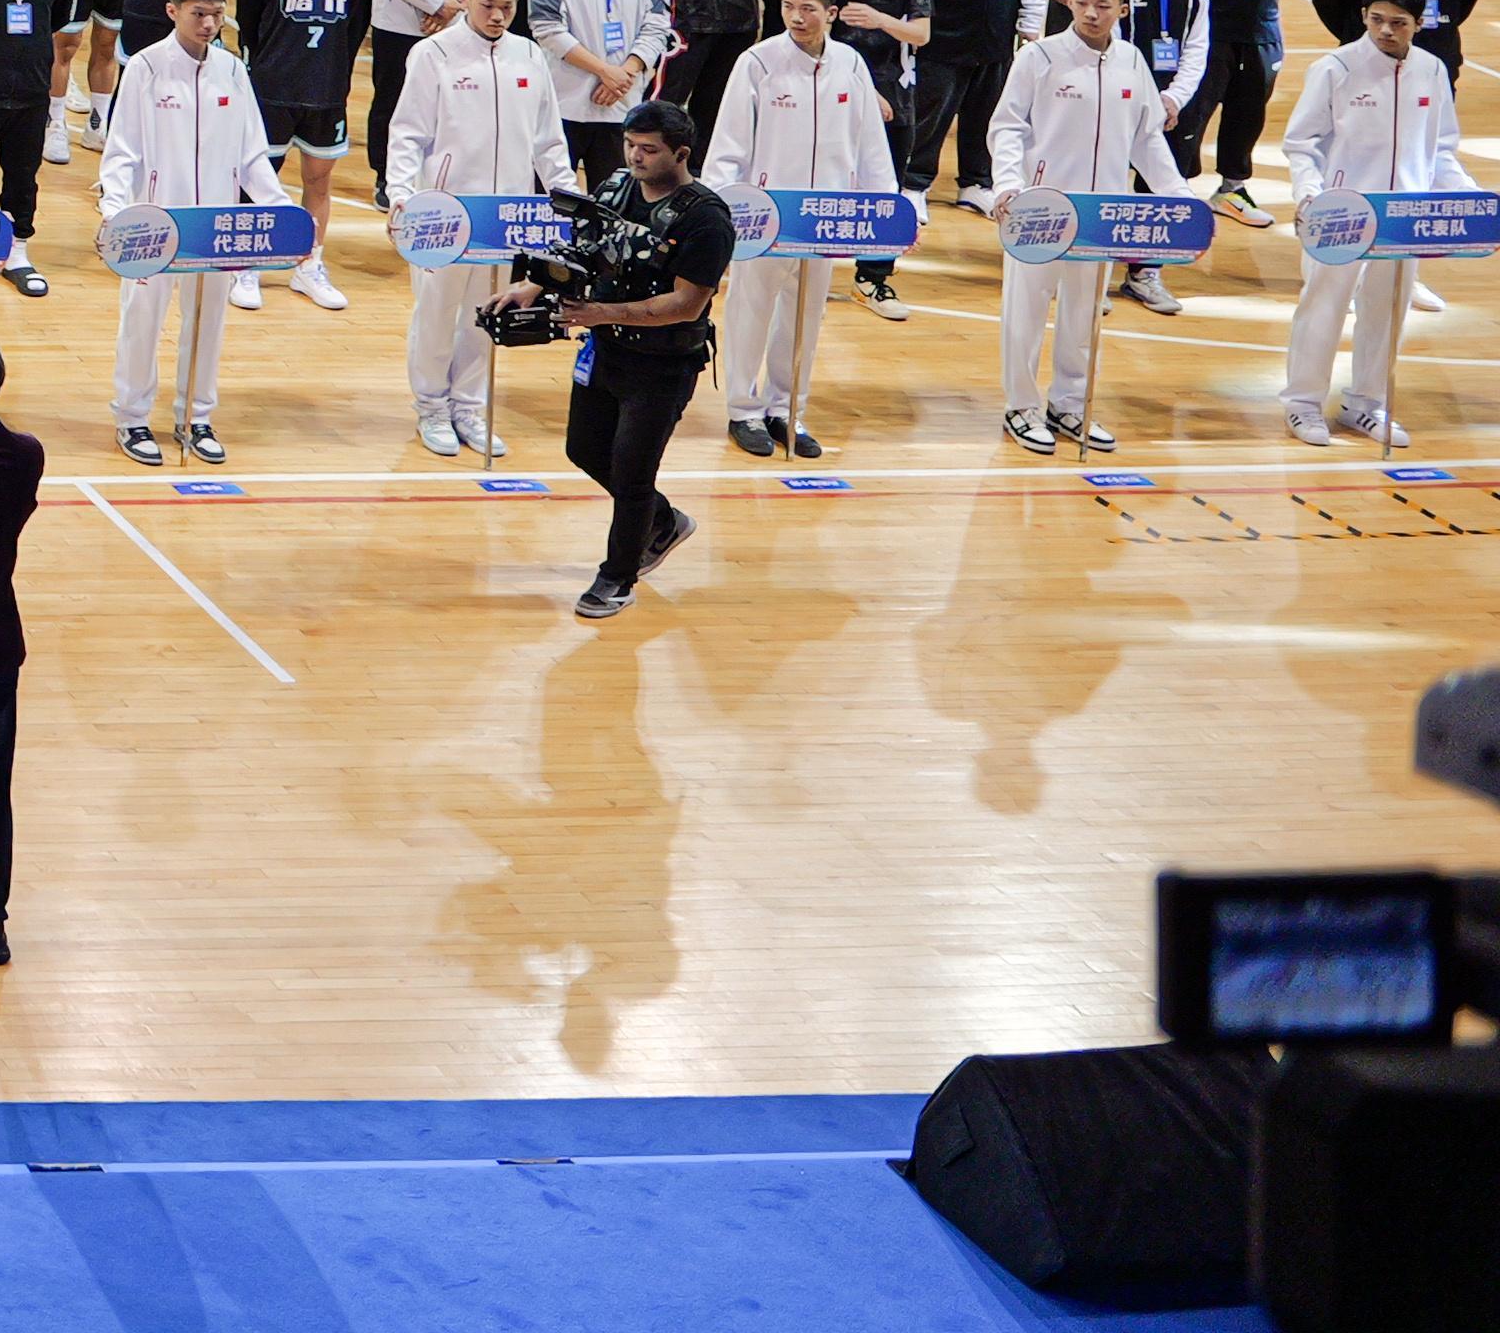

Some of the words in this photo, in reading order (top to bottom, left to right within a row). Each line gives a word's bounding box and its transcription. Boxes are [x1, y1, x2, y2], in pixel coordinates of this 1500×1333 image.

[308, 25, 322, 47] 7
[799, 198, 894, 218] 兵团第十师
[1099, 203, 1192, 222] 石河子大学
[214, 213, 275, 232] 哈密市
[816, 219, 875, 240] 代表队
[1413, 216, 1468, 237] 代表队
[213, 232, 272, 253] 代表队
[504, 225, 563, 246] 代表队
[1112, 224, 1170, 244] 代表队
